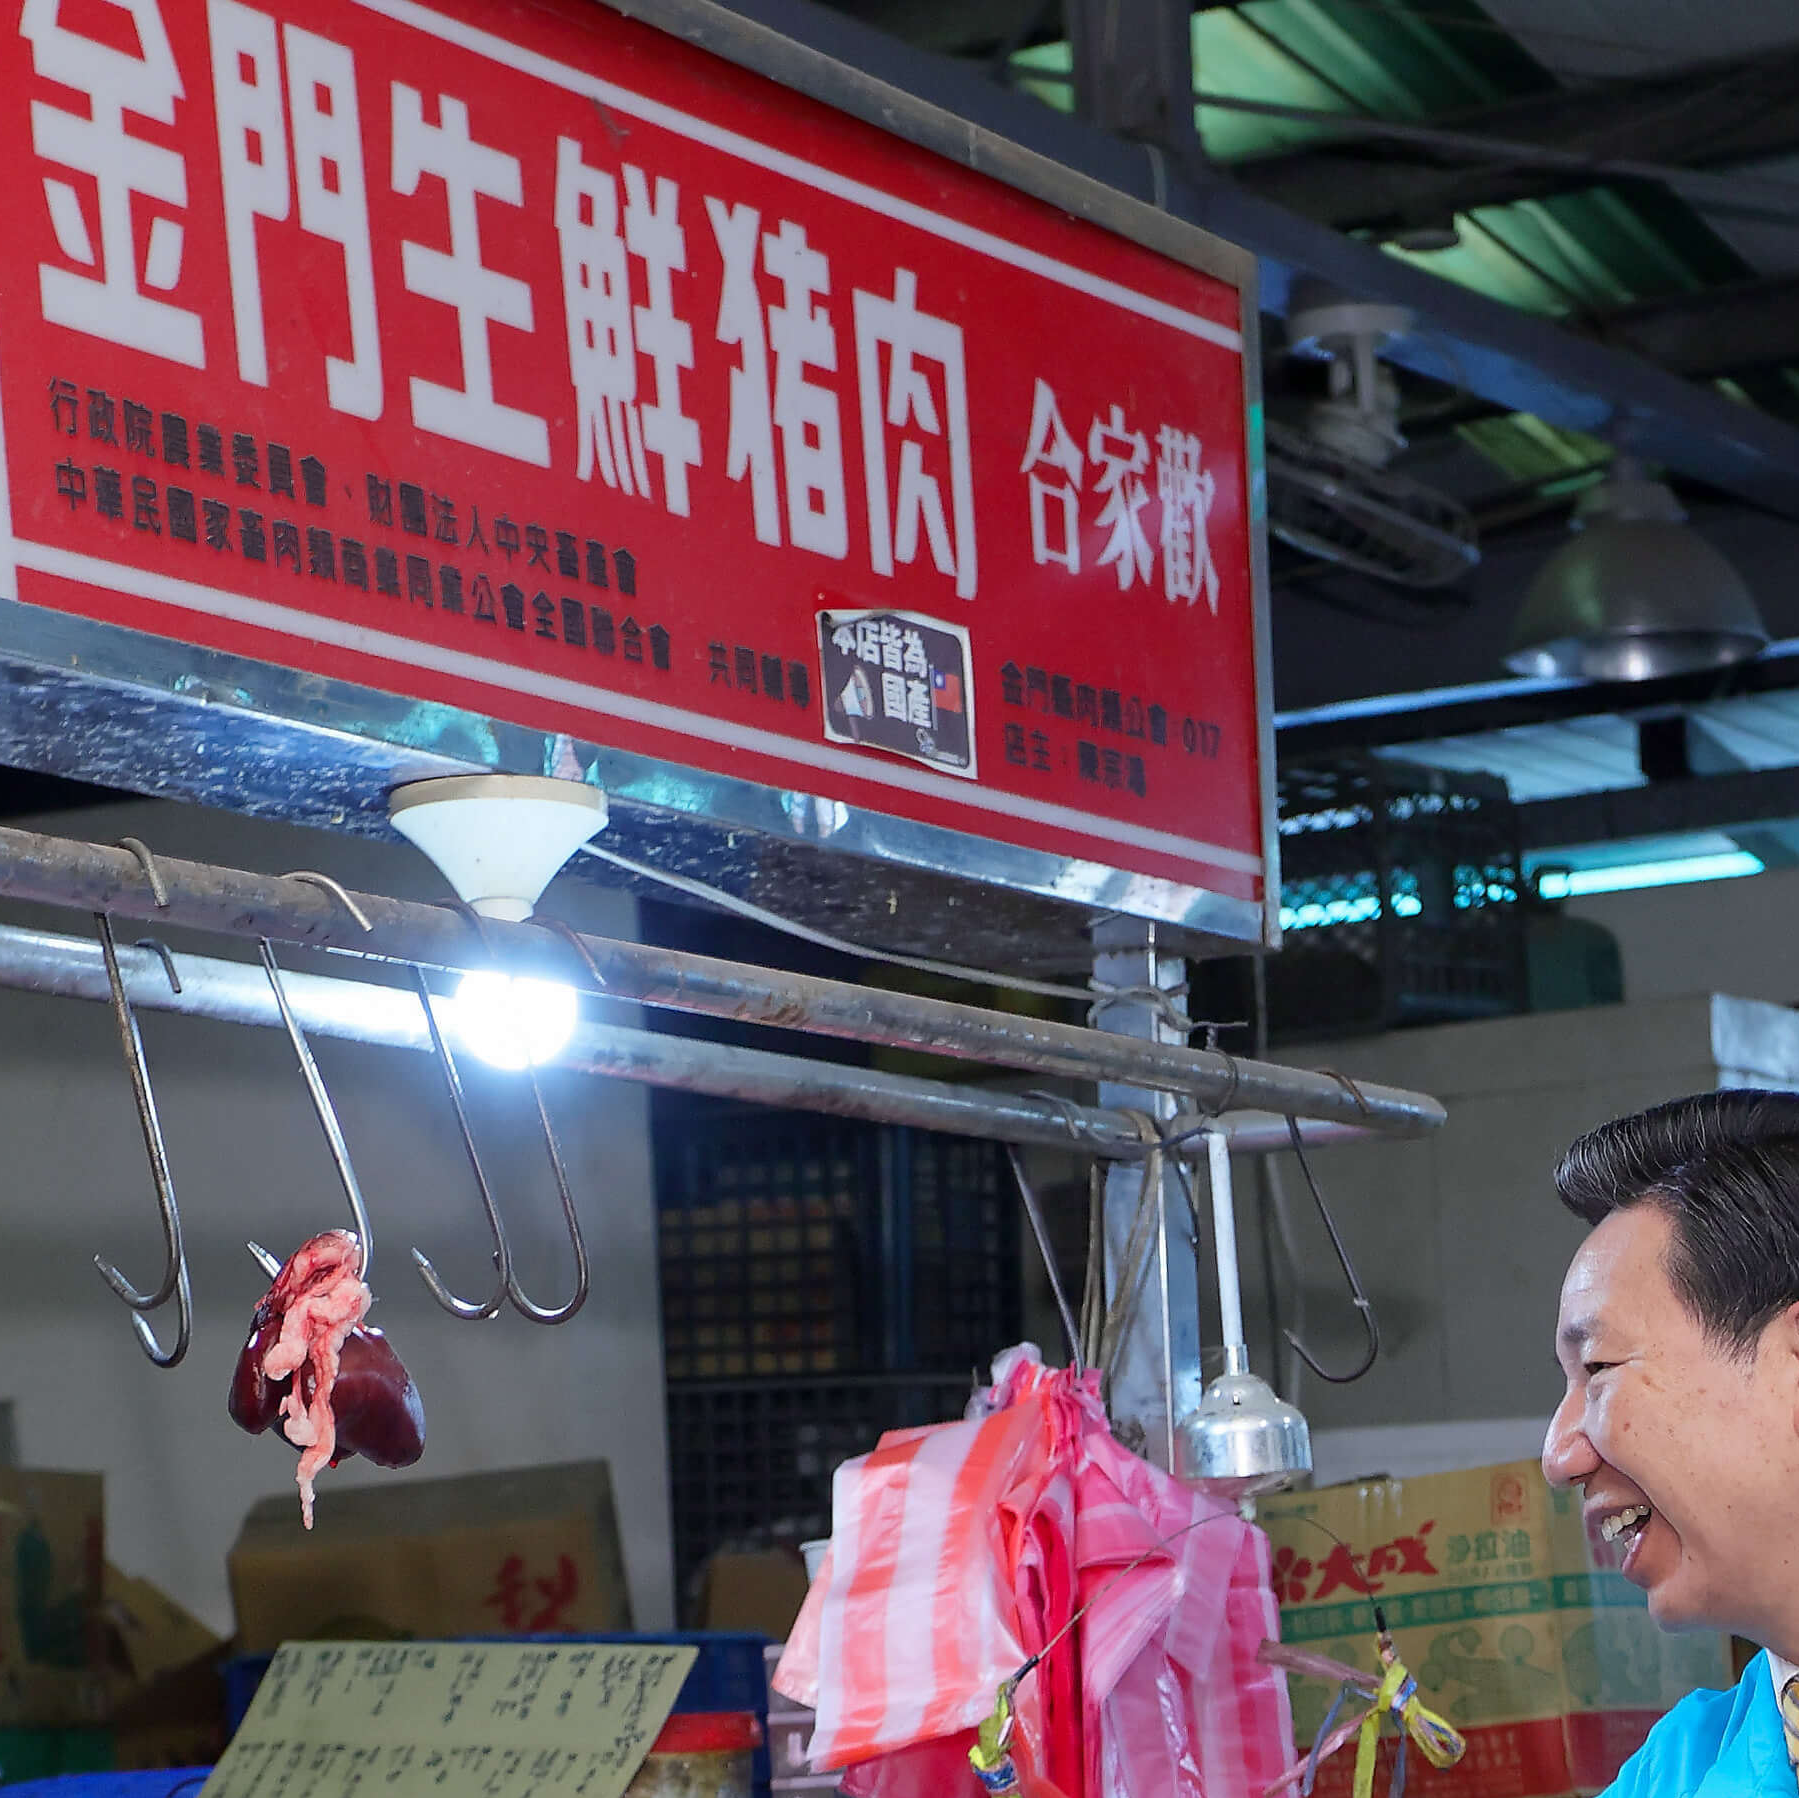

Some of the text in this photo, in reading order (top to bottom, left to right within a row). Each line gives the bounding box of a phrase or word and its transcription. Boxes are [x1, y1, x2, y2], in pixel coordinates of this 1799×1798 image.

[1019, 376, 1220, 615] 合家歡
[831, 619, 929, 679] 本店皆為
[881, 671, 934, 730] 國產
[1313, 1519, 1439, 1600] 大成
